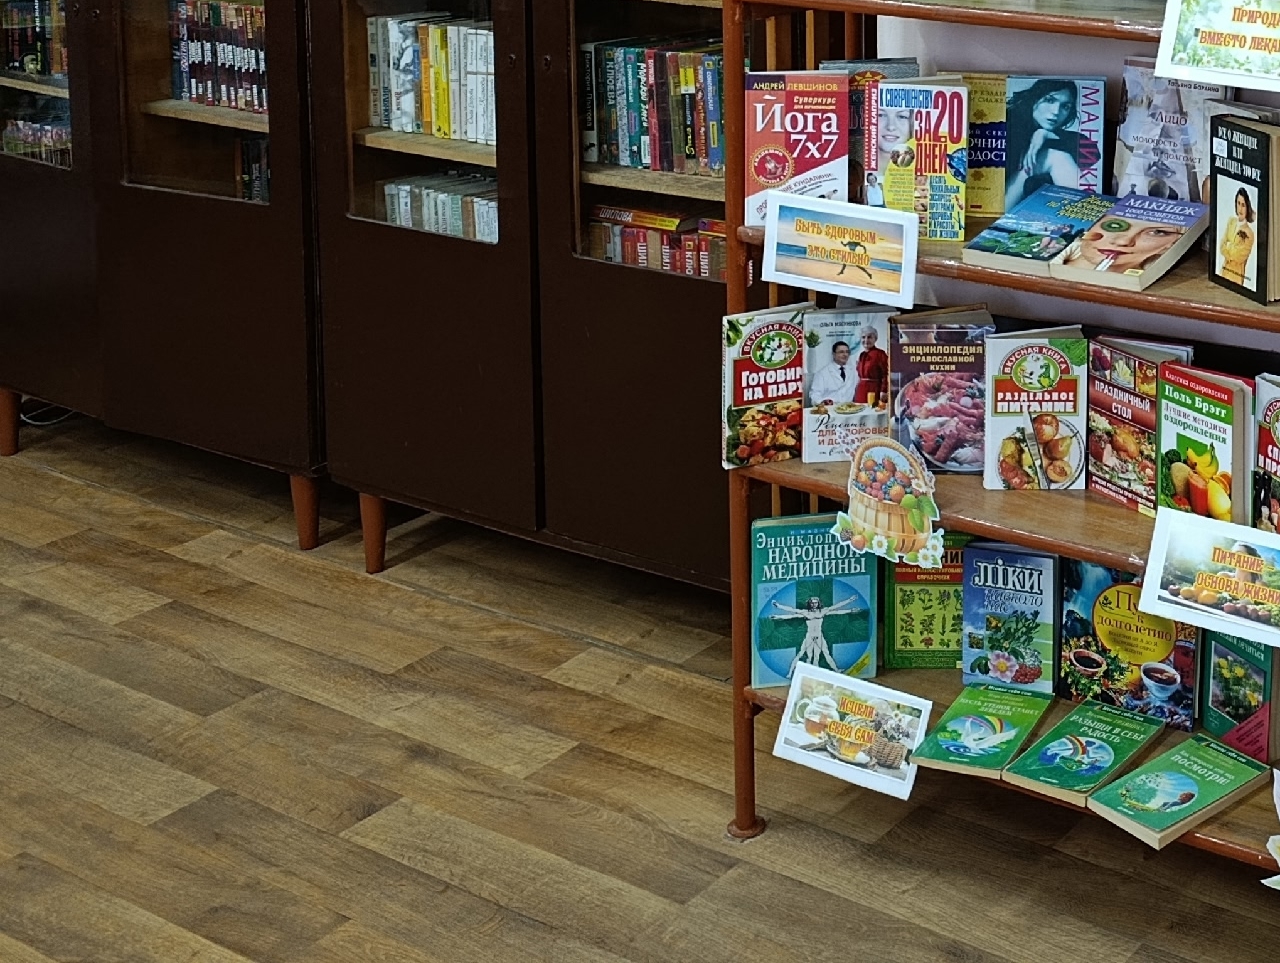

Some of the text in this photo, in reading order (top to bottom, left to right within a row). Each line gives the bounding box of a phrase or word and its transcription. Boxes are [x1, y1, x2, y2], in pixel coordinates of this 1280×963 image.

[1199, 30, 1247, 49] ВМЕСТО
[753, 81, 838, 91] АНДРЕЙ ЛЕВШИНОВ
[793, 96, 836, 106] Суперкурс
[885, 88, 933, 110] СОВЕРШЕНСТВУ
[754, 94, 839, 133] Йога
[1155, 112, 1187, 126] Лицо
[869, 88, 878, 170] ЖЕНСКИЙ КАПРИЗ
[915, 111, 931, 143] ЗА
[1133, 136, 1178, 148] молодость
[915, 142, 948, 176] ДНЕЙ
[1125, 198, 1198, 216] МАКИЯЖ
[795, 218, 877, 245] БЫТЬ ЗДОРОВЫМ
[807, 246, 870, 266] ЭТО СТИЛЬНО
[902, 344, 983, 355] ЭНЦИКЛОПЕДИЯ
[910, 355, 975, 364] ПРАВОСЛАВНОЙ
[997, 392, 1075, 401] РАЗДЕЛЬНОЕ
[997, 401, 1075, 414] ПИТАНИЕ
[1094, 380, 1150, 413] ПРАЗДНИЧНЫЙ
[1164, 384, 1227, 419] Поль Брэгг
[1112, 401, 1132, 421] СТОЛ
[1163, 413, 1227, 445] оздоровления
[762, 558, 867, 581] МЕДИЦИНЫ
[1212, 547, 1265, 574] ПИТАНИЕ
[973, 558, 1042, 594] ЛІКИ
[1195, 571, 1240, 594] ОСНОВА
[1098, 615, 1172, 642] долголетию
[839, 696, 876, 719] ИСЦЕЛИ
[827, 718, 874, 744] СЕБЯ САМ
